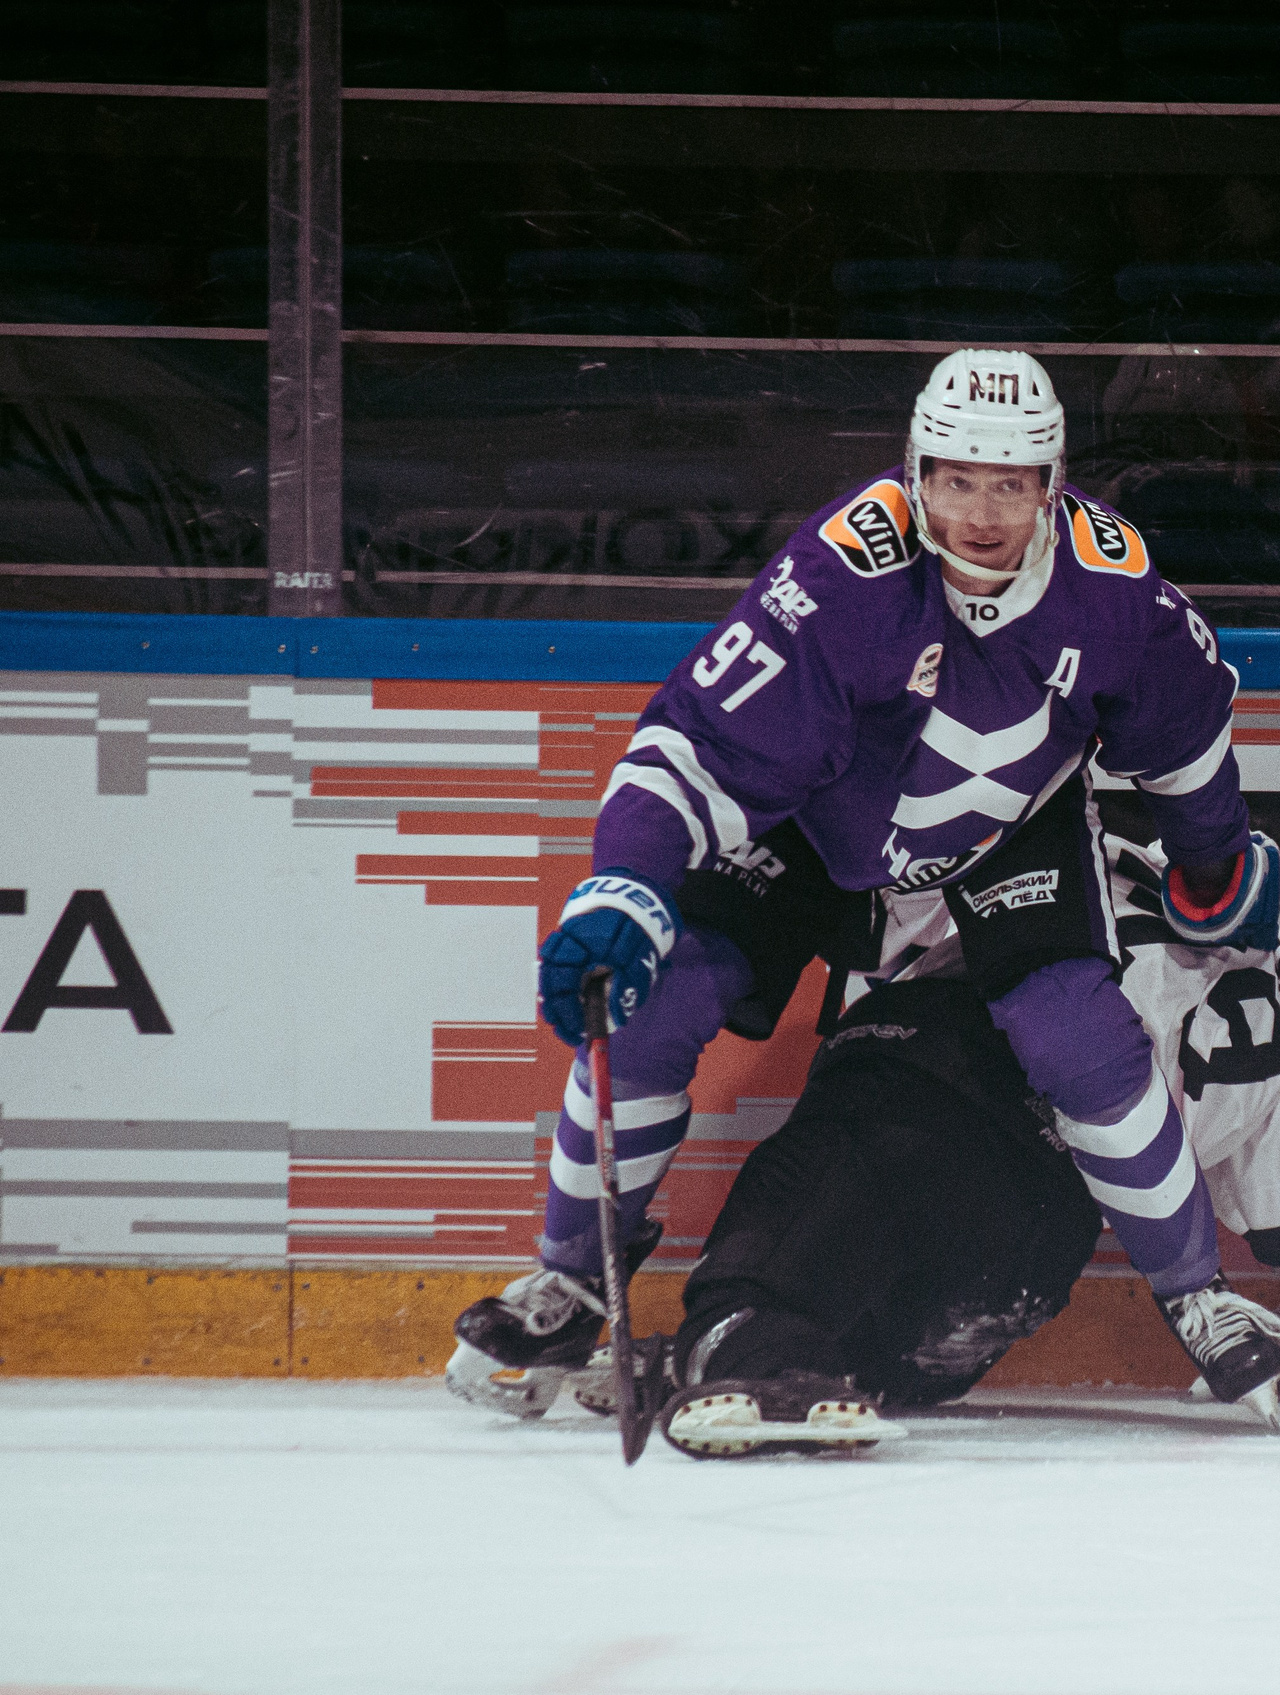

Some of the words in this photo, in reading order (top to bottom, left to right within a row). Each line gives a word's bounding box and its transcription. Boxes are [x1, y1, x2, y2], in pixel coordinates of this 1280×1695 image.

[966, 603, 999, 621] 10
[692, 621, 787, 713] 97
[1011, 890, 1049, 906] ЛЁД
